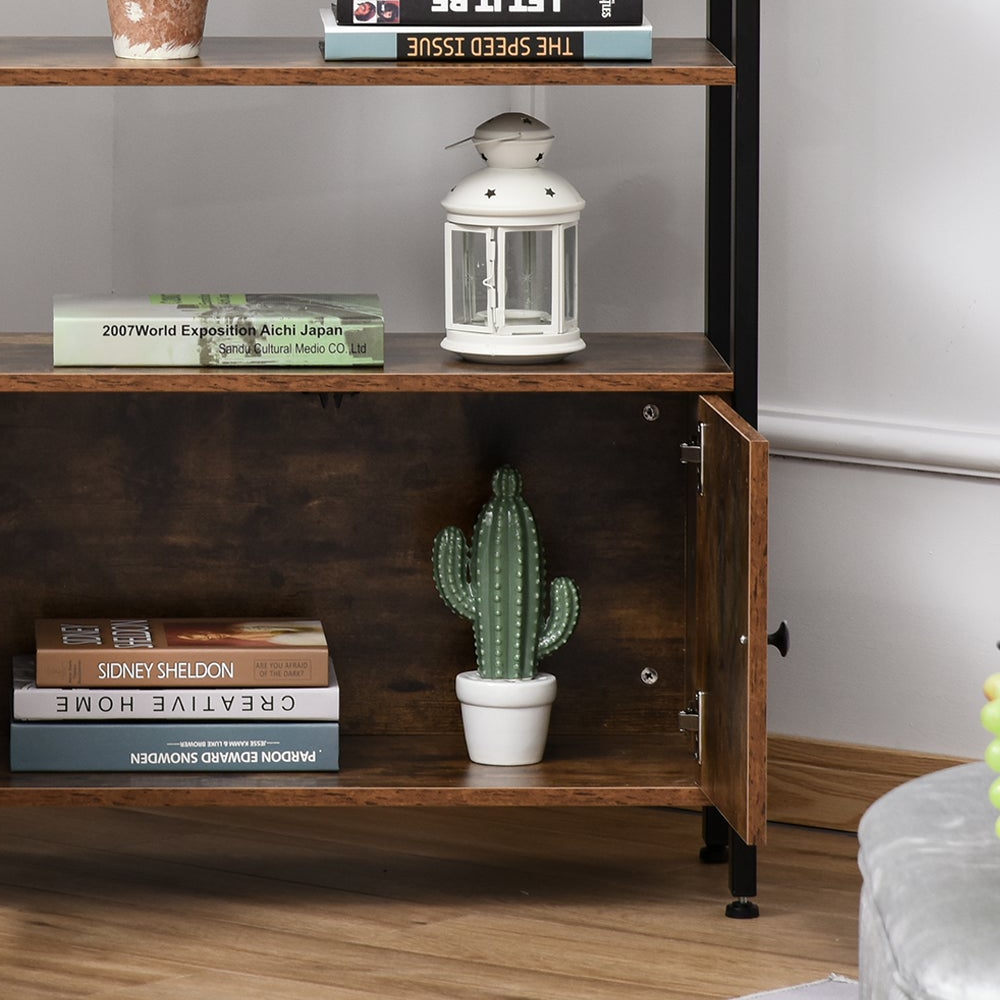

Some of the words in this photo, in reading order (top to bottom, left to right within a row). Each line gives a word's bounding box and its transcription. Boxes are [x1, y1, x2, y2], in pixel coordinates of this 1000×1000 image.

[407, 38, 465, 57] ISSUE
[471, 37, 531, 57] SPEED
[536, 36, 574, 56] THE
[102, 324, 177, 337] 2007World
[181, 324, 256, 338] Exposition
[260, 324, 296, 337] Aichi
[300, 324, 343, 338] Japan
[218, 342, 250, 354] Sandu
[254, 342, 292, 354] Cultural
[296, 343, 326, 354] Medio
[98, 662, 154, 679] SIDNEY
[157, 662, 234, 679] SHELDON
[259, 670, 268, 678] OF
[270, 670, 282, 678] THE
[56, 696, 134, 713] HOME
[152, 695, 296, 712] CREATIVE
[223, 740, 228, 748] &
[229, 740, 249, 748] KAMM
[130, 752, 198, 764] SNOWDEN
[201, 751, 259, 764] EDWARD
[261, 750, 316, 763] PARDON
